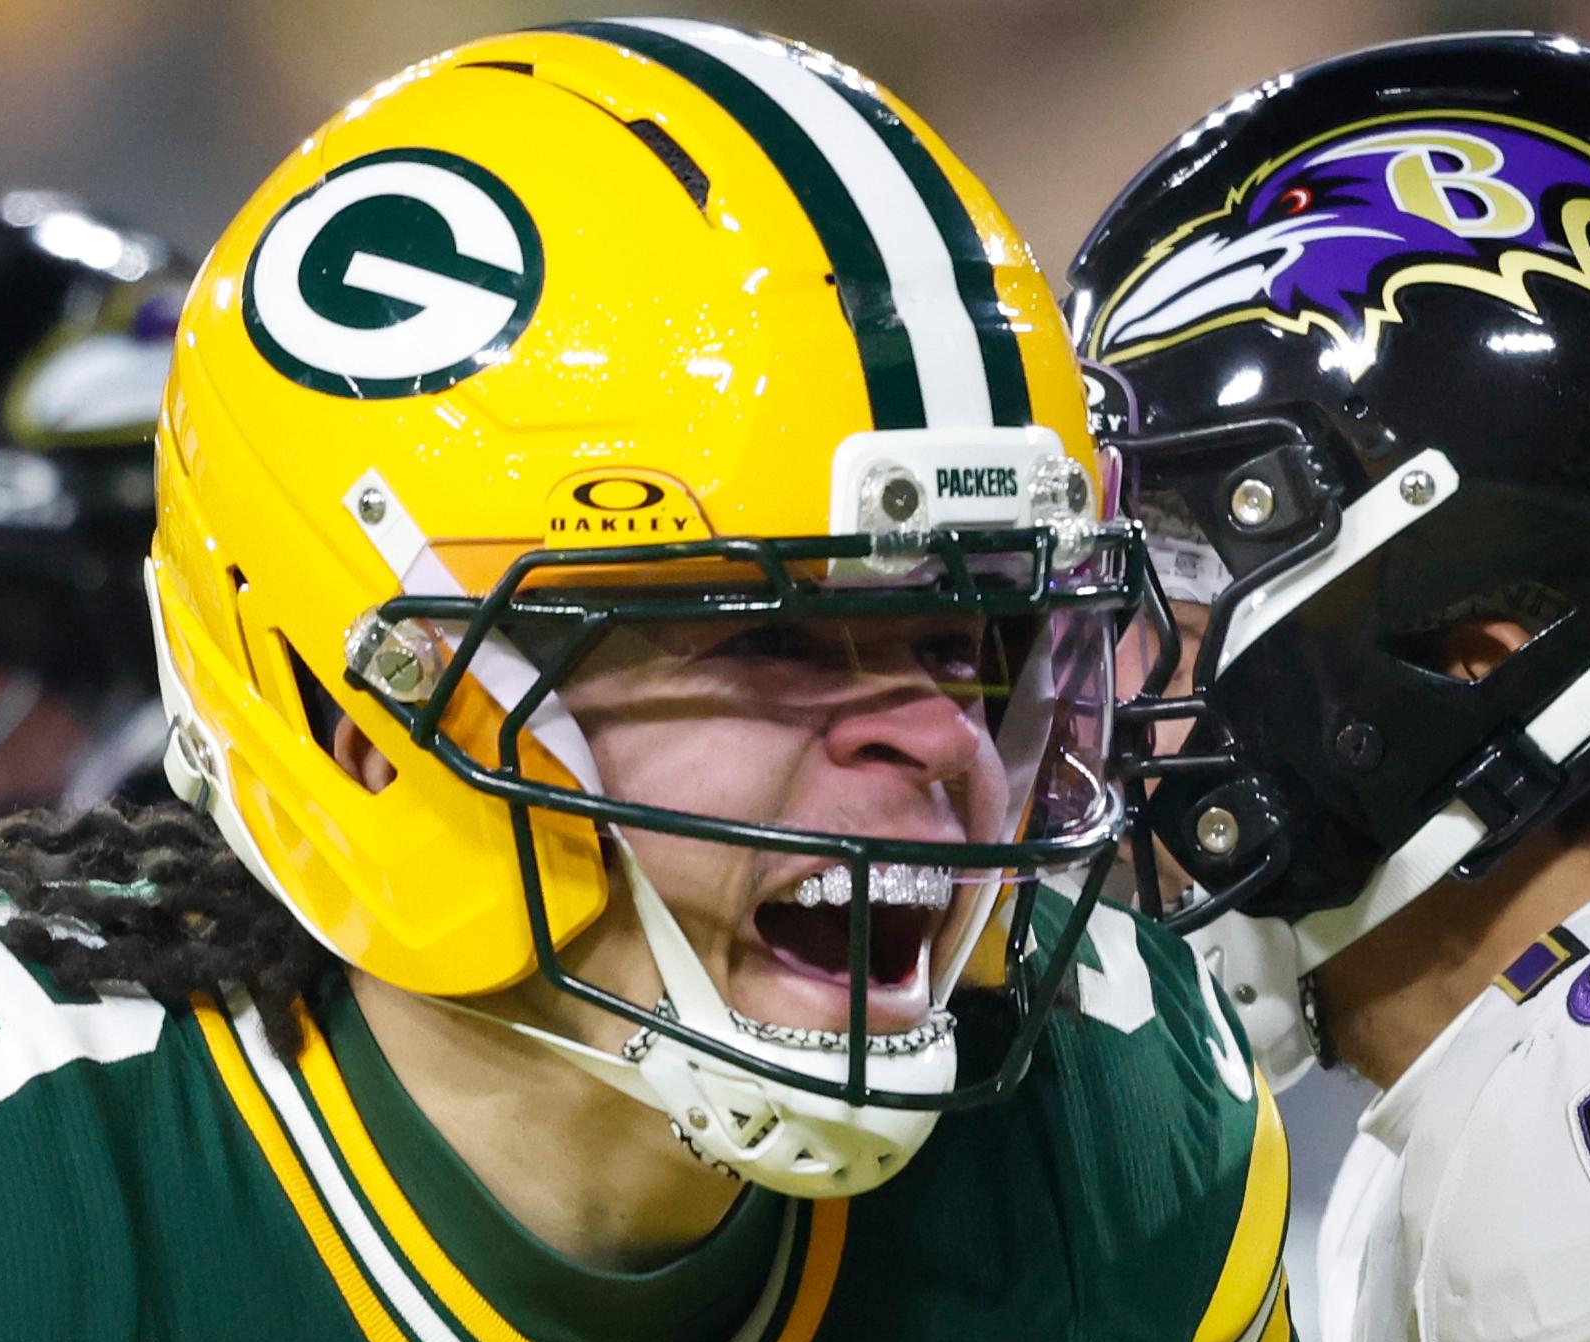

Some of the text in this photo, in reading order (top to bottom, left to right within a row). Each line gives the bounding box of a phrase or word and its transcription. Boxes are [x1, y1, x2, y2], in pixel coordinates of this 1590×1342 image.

[1383, 128, 1535, 239] B
[251, 161, 525, 380] G
[936, 467, 1019, 498] PACKERS
[550, 516, 688, 533] OAKLEY
